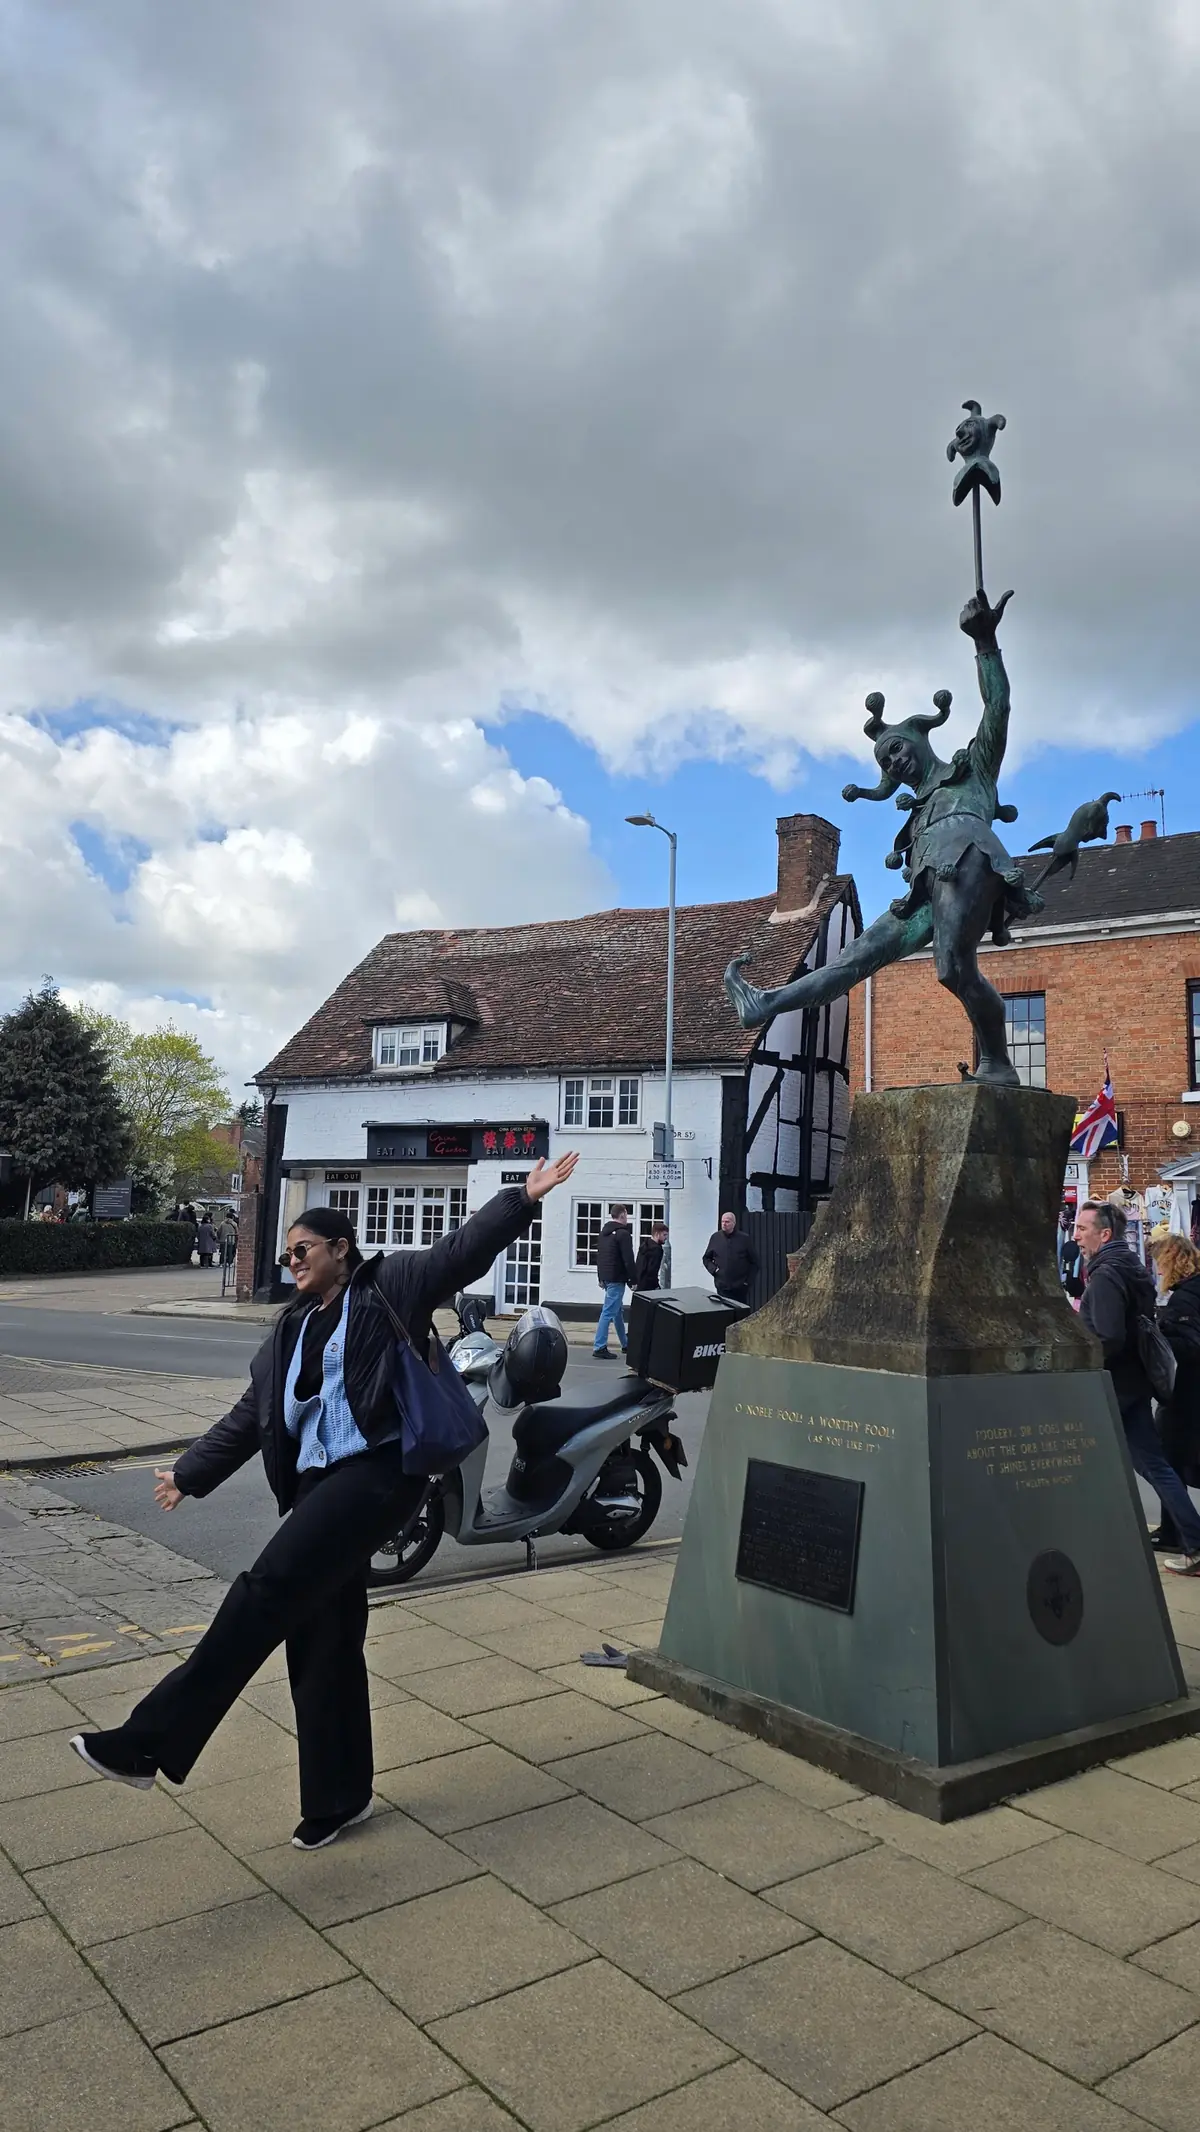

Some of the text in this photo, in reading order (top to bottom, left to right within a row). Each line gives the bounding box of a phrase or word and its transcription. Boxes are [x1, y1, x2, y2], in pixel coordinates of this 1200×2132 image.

[376, 1148, 416, 1156] EAT IN
[486, 1146, 535, 1154] EAT OUT
[735, 1403, 742, 1412] O
[746, 1404, 773, 1418] NOBLE
[808, 1416, 814, 1426] A
[820, 1416, 860, 1432] WORTHY
[865, 1424, 894, 1439] FOOL!
[826, 1436, 842, 1446] YOU
[846, 1440, 862, 1450] LIKE
[966, 1446, 996, 1460] ABOUT
[1000, 1446, 1016, 1458] THE
[1021, 1442, 1037, 1454] ORB
[986, 1464, 995, 1476] IT
[1000, 1461, 1028, 1474] SHINES
